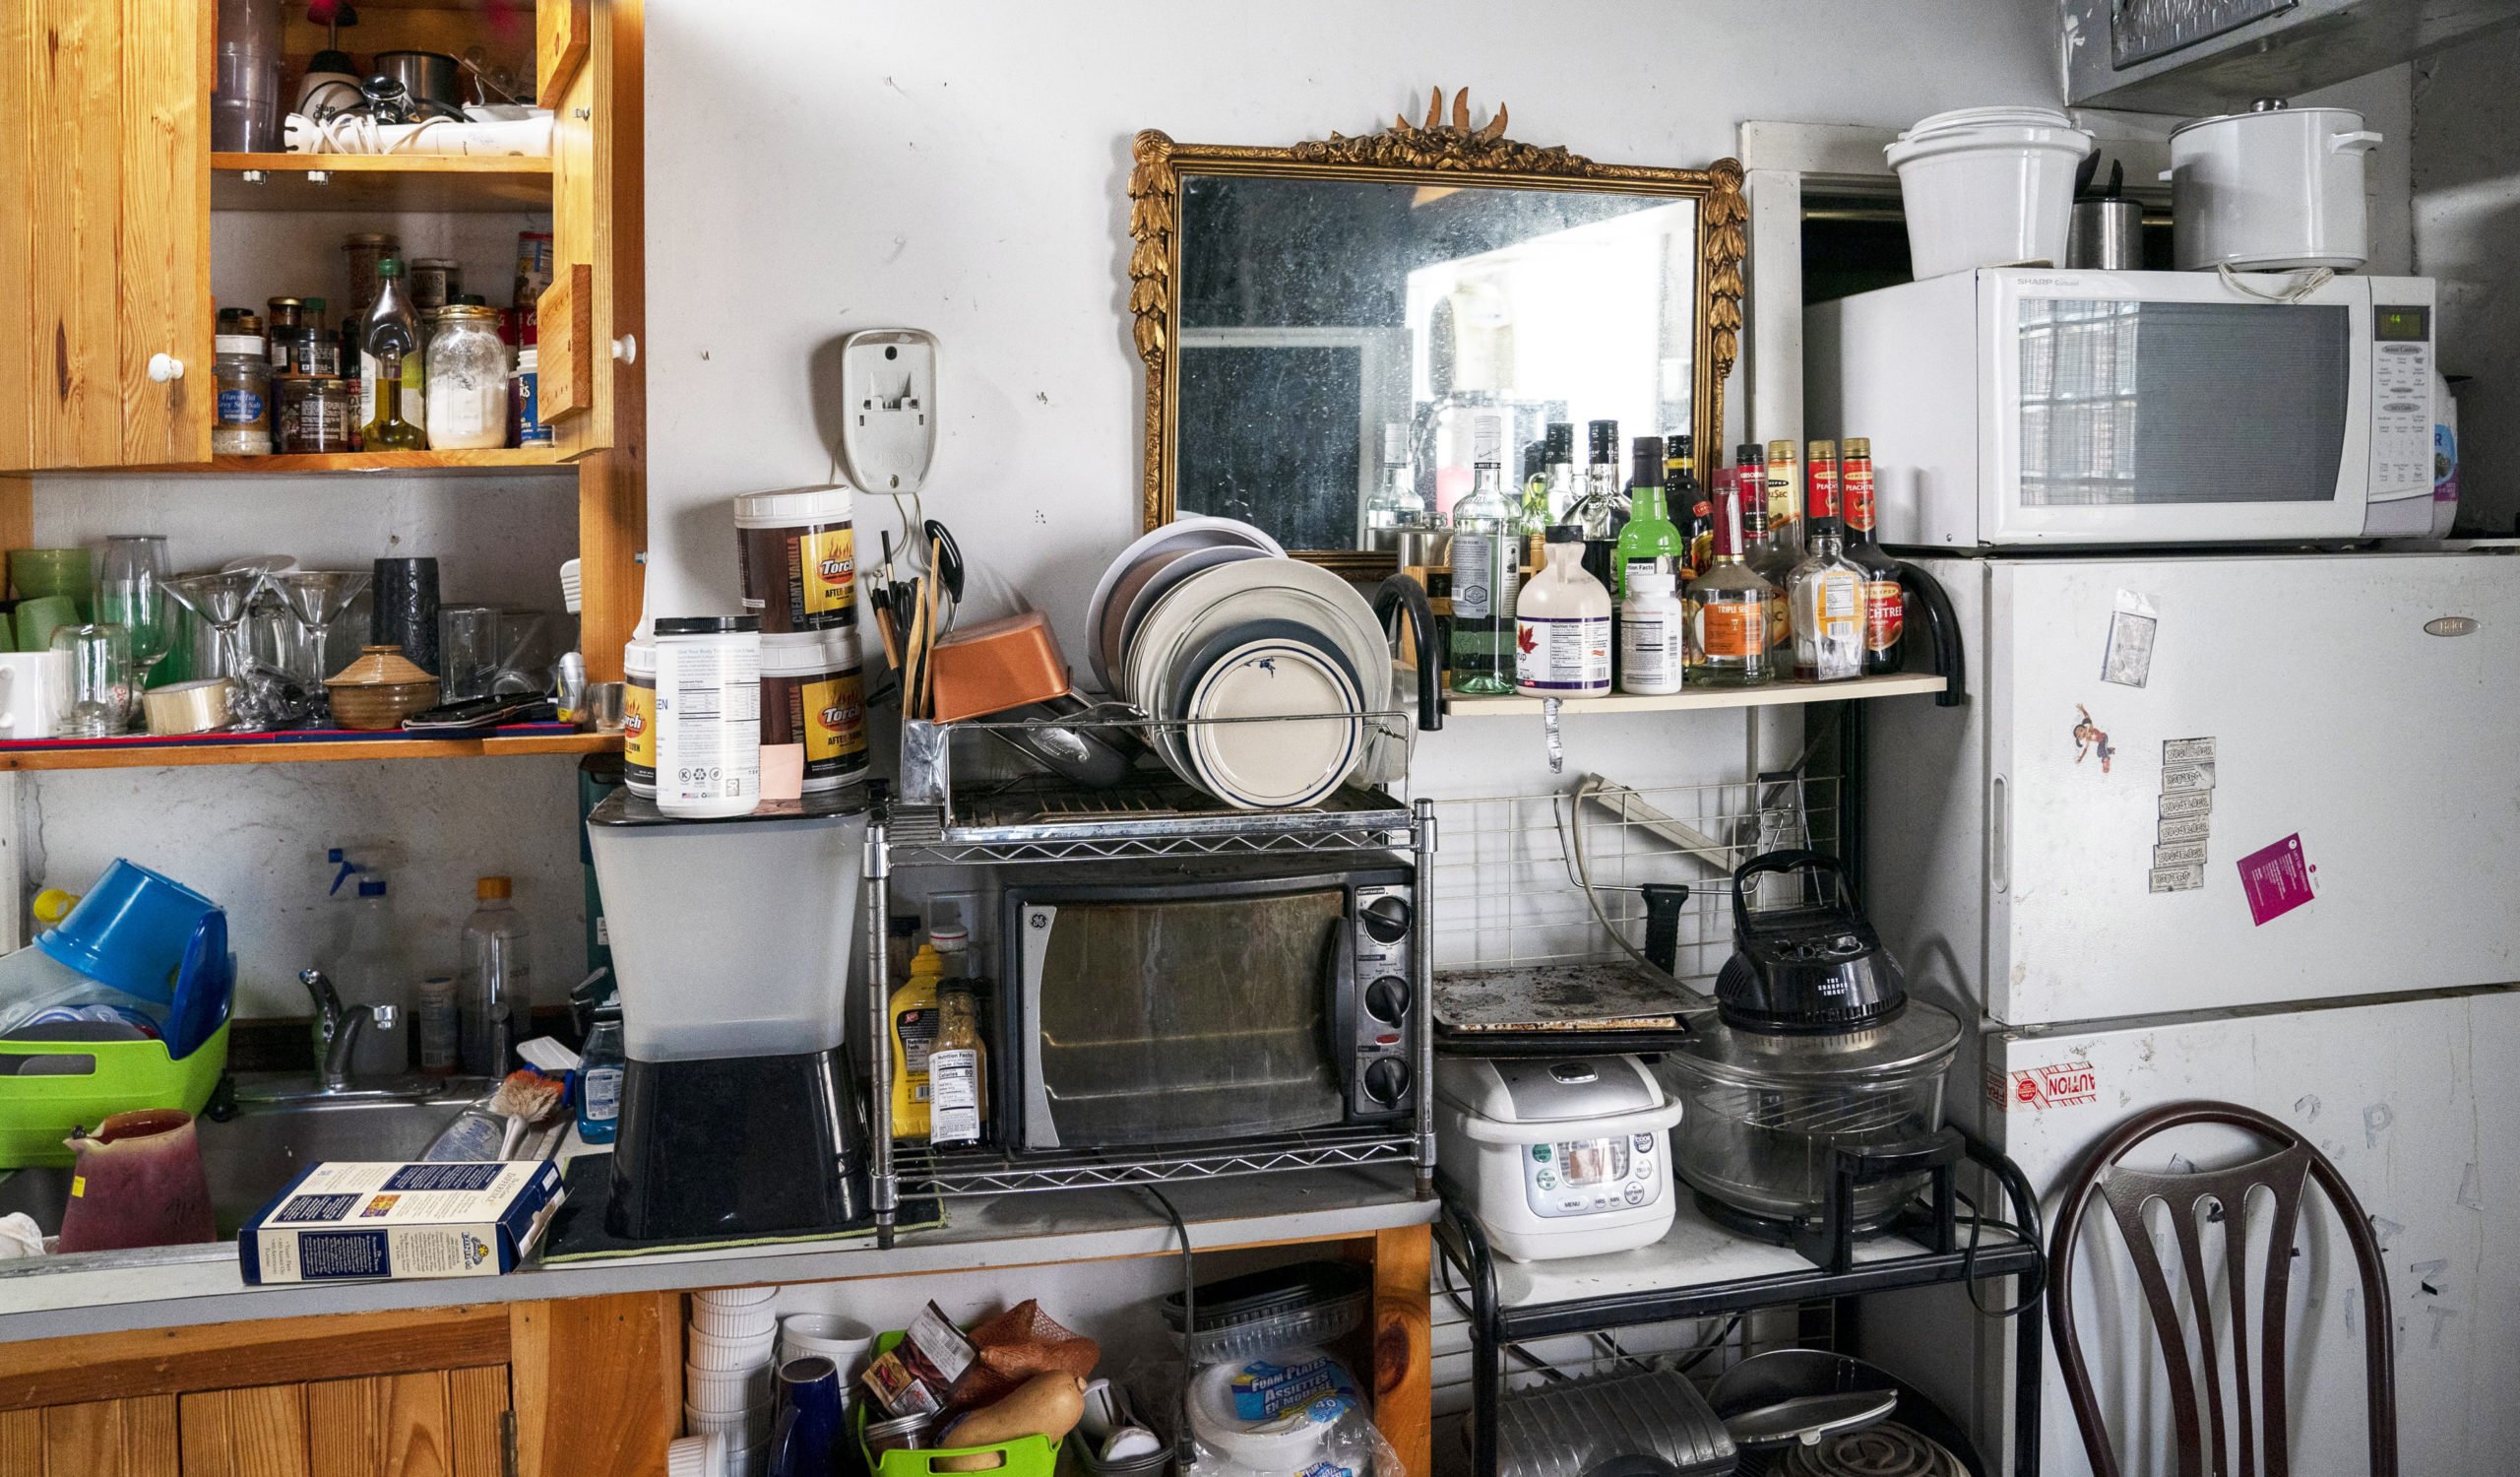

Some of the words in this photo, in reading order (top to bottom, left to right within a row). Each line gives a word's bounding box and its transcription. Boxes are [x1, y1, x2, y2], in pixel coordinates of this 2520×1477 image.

[788, 537, 801, 578] VANILLA
[822, 556, 854, 575] Torch
[789, 578, 804, 622] CREAMY
[825, 589, 843, 599] AFTER
[1718, 606, 1737, 614] TRIPLE
[823, 705, 860, 724] Torch
[1817, 982, 1848, 991] SHARPER
[938, 1070, 959, 1079] Calories
[1252, 1374, 1284, 1392] FOAM
[1287, 1358, 1328, 1380] PLATES
[1264, 1371, 1330, 1404] ASSIETTES
[1265, 1402, 1280, 1416] EN
[1315, 1399, 1337, 1409] 40
